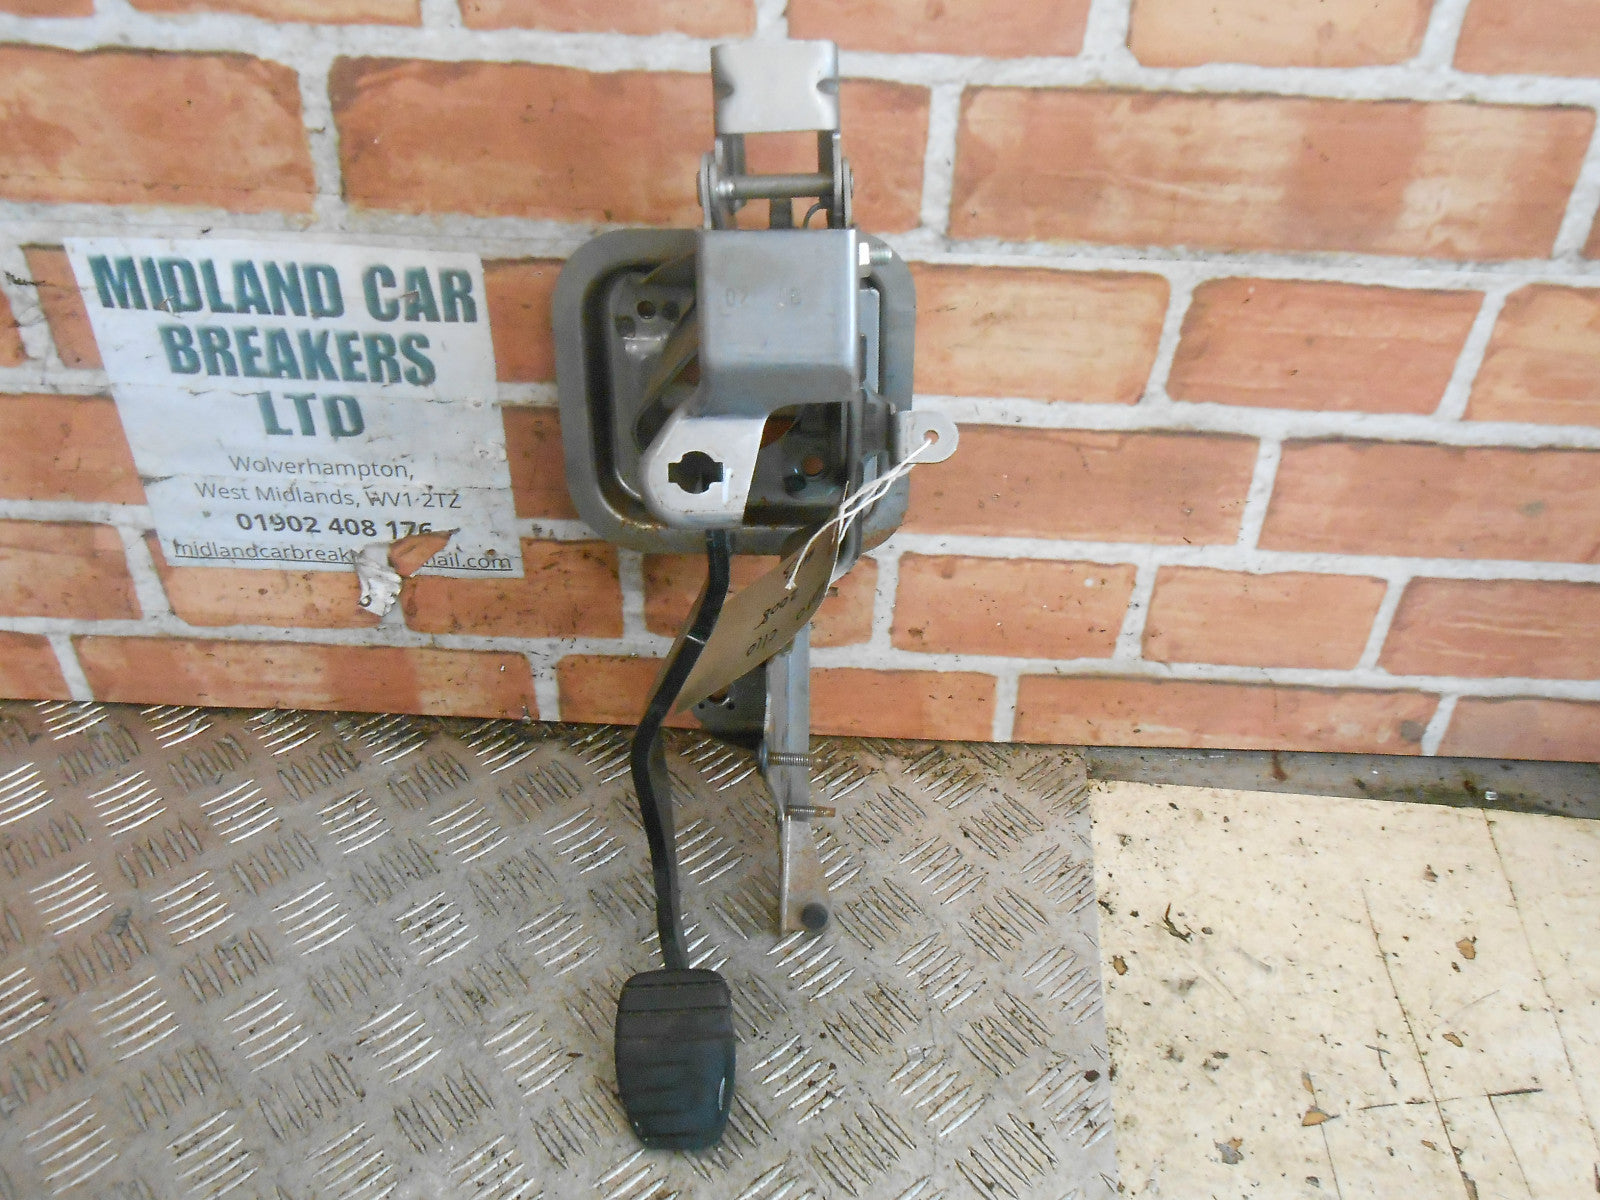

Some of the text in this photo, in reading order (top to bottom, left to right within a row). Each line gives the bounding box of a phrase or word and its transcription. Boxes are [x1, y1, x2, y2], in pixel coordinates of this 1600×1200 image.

[87, 254, 478, 323] MIDLAND CAR
[158, 323, 437, 386] BREAKERS
[256, 390, 365, 437] LTD
[229, 455, 414, 481] Wolverhampton,
[194, 482, 462, 509] West Midlands, WV1 2TZ
[236, 513, 321, 534] 01902
[328, 517, 377, 537] 408
